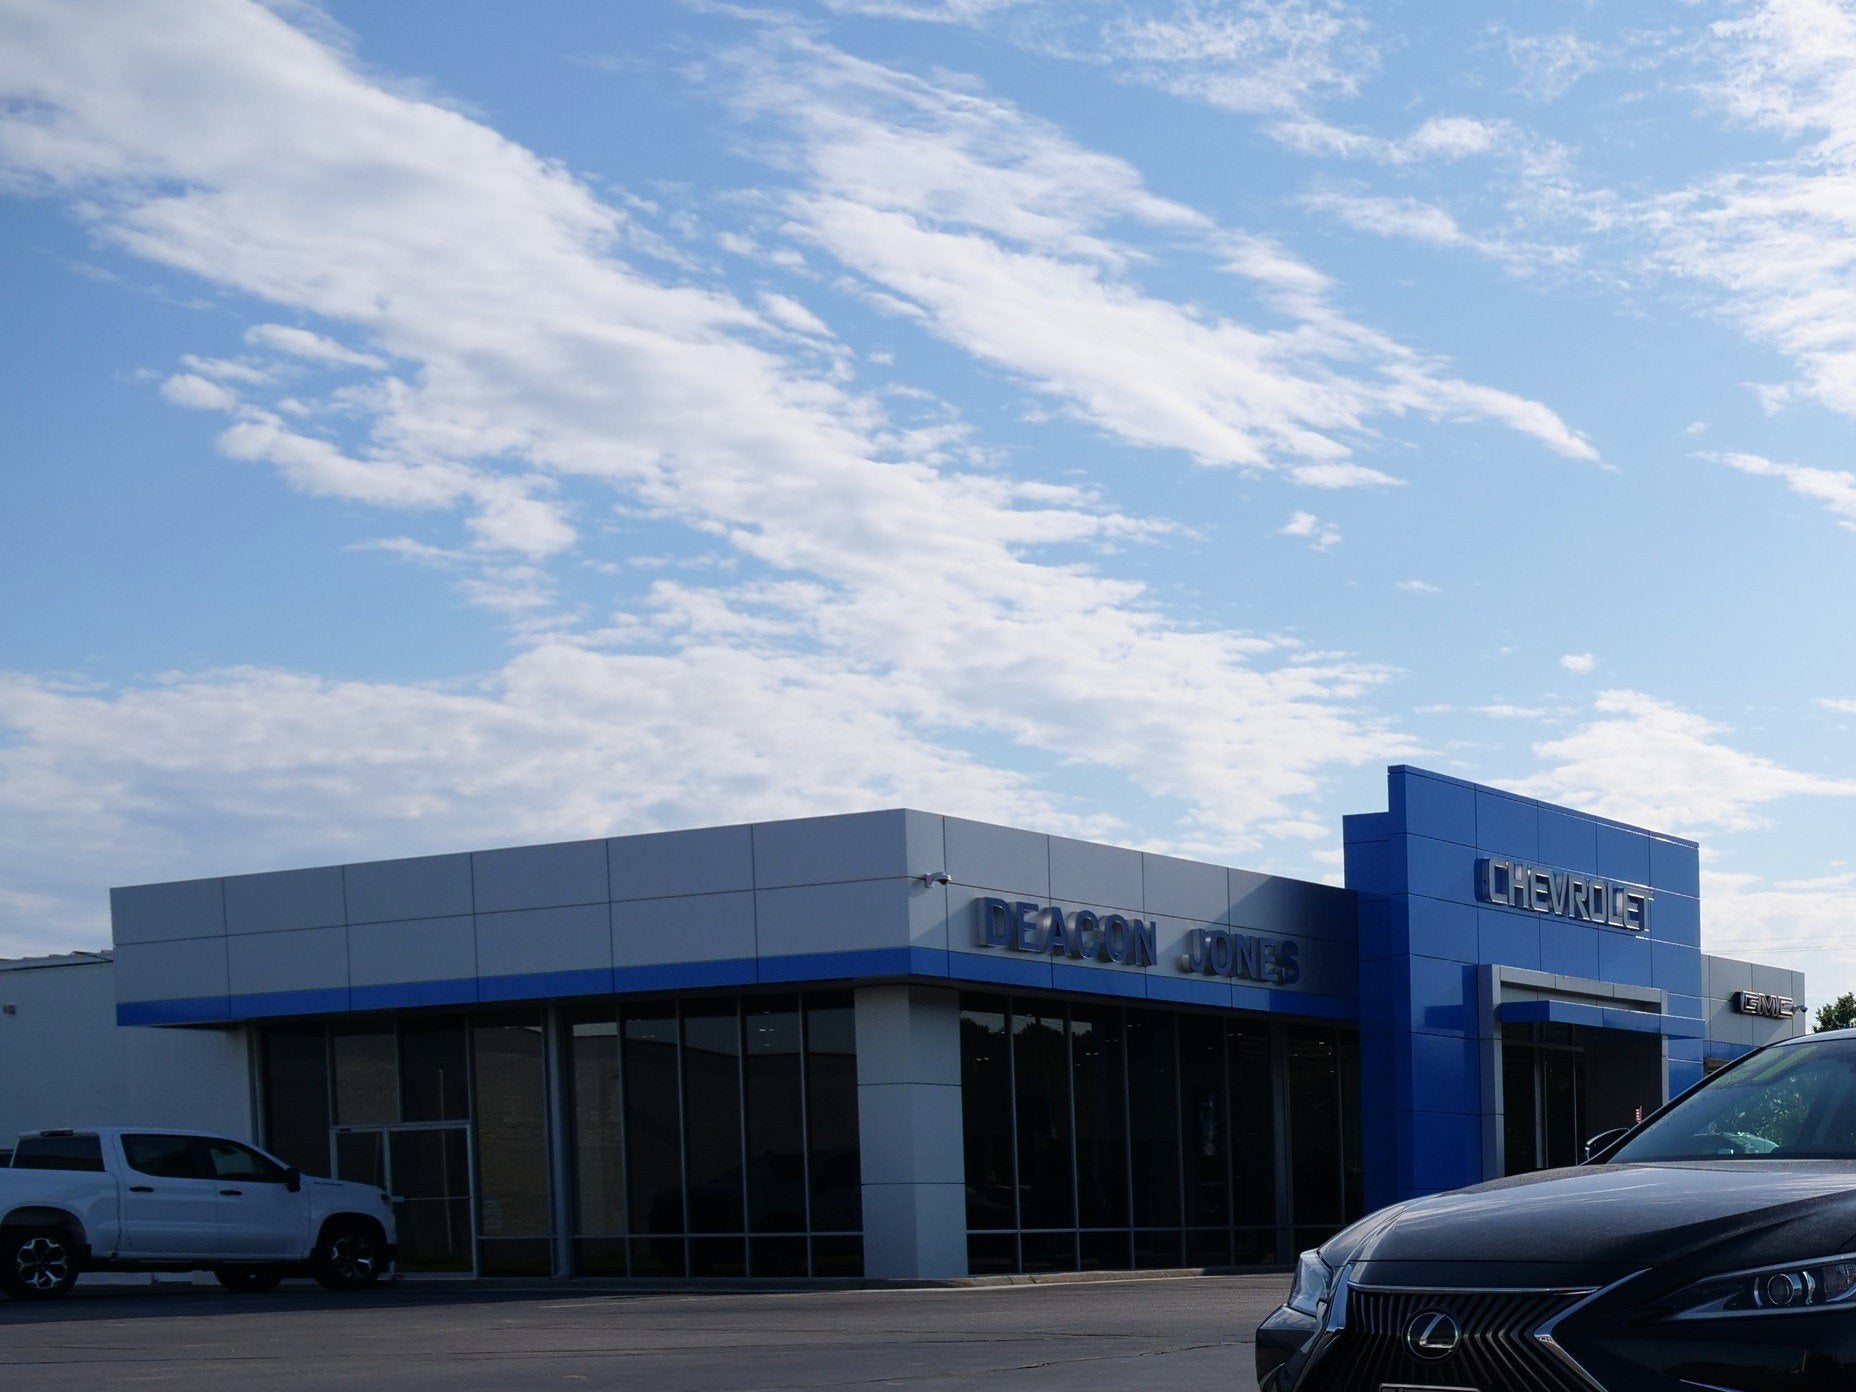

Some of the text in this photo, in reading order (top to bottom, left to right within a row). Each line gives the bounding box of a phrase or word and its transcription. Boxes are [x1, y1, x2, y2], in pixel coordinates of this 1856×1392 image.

[1476, 857, 1655, 932] CHEVROLET
[976, 897, 1300, 985] DEACON JONES
[1740, 989, 1795, 1019] GMC
